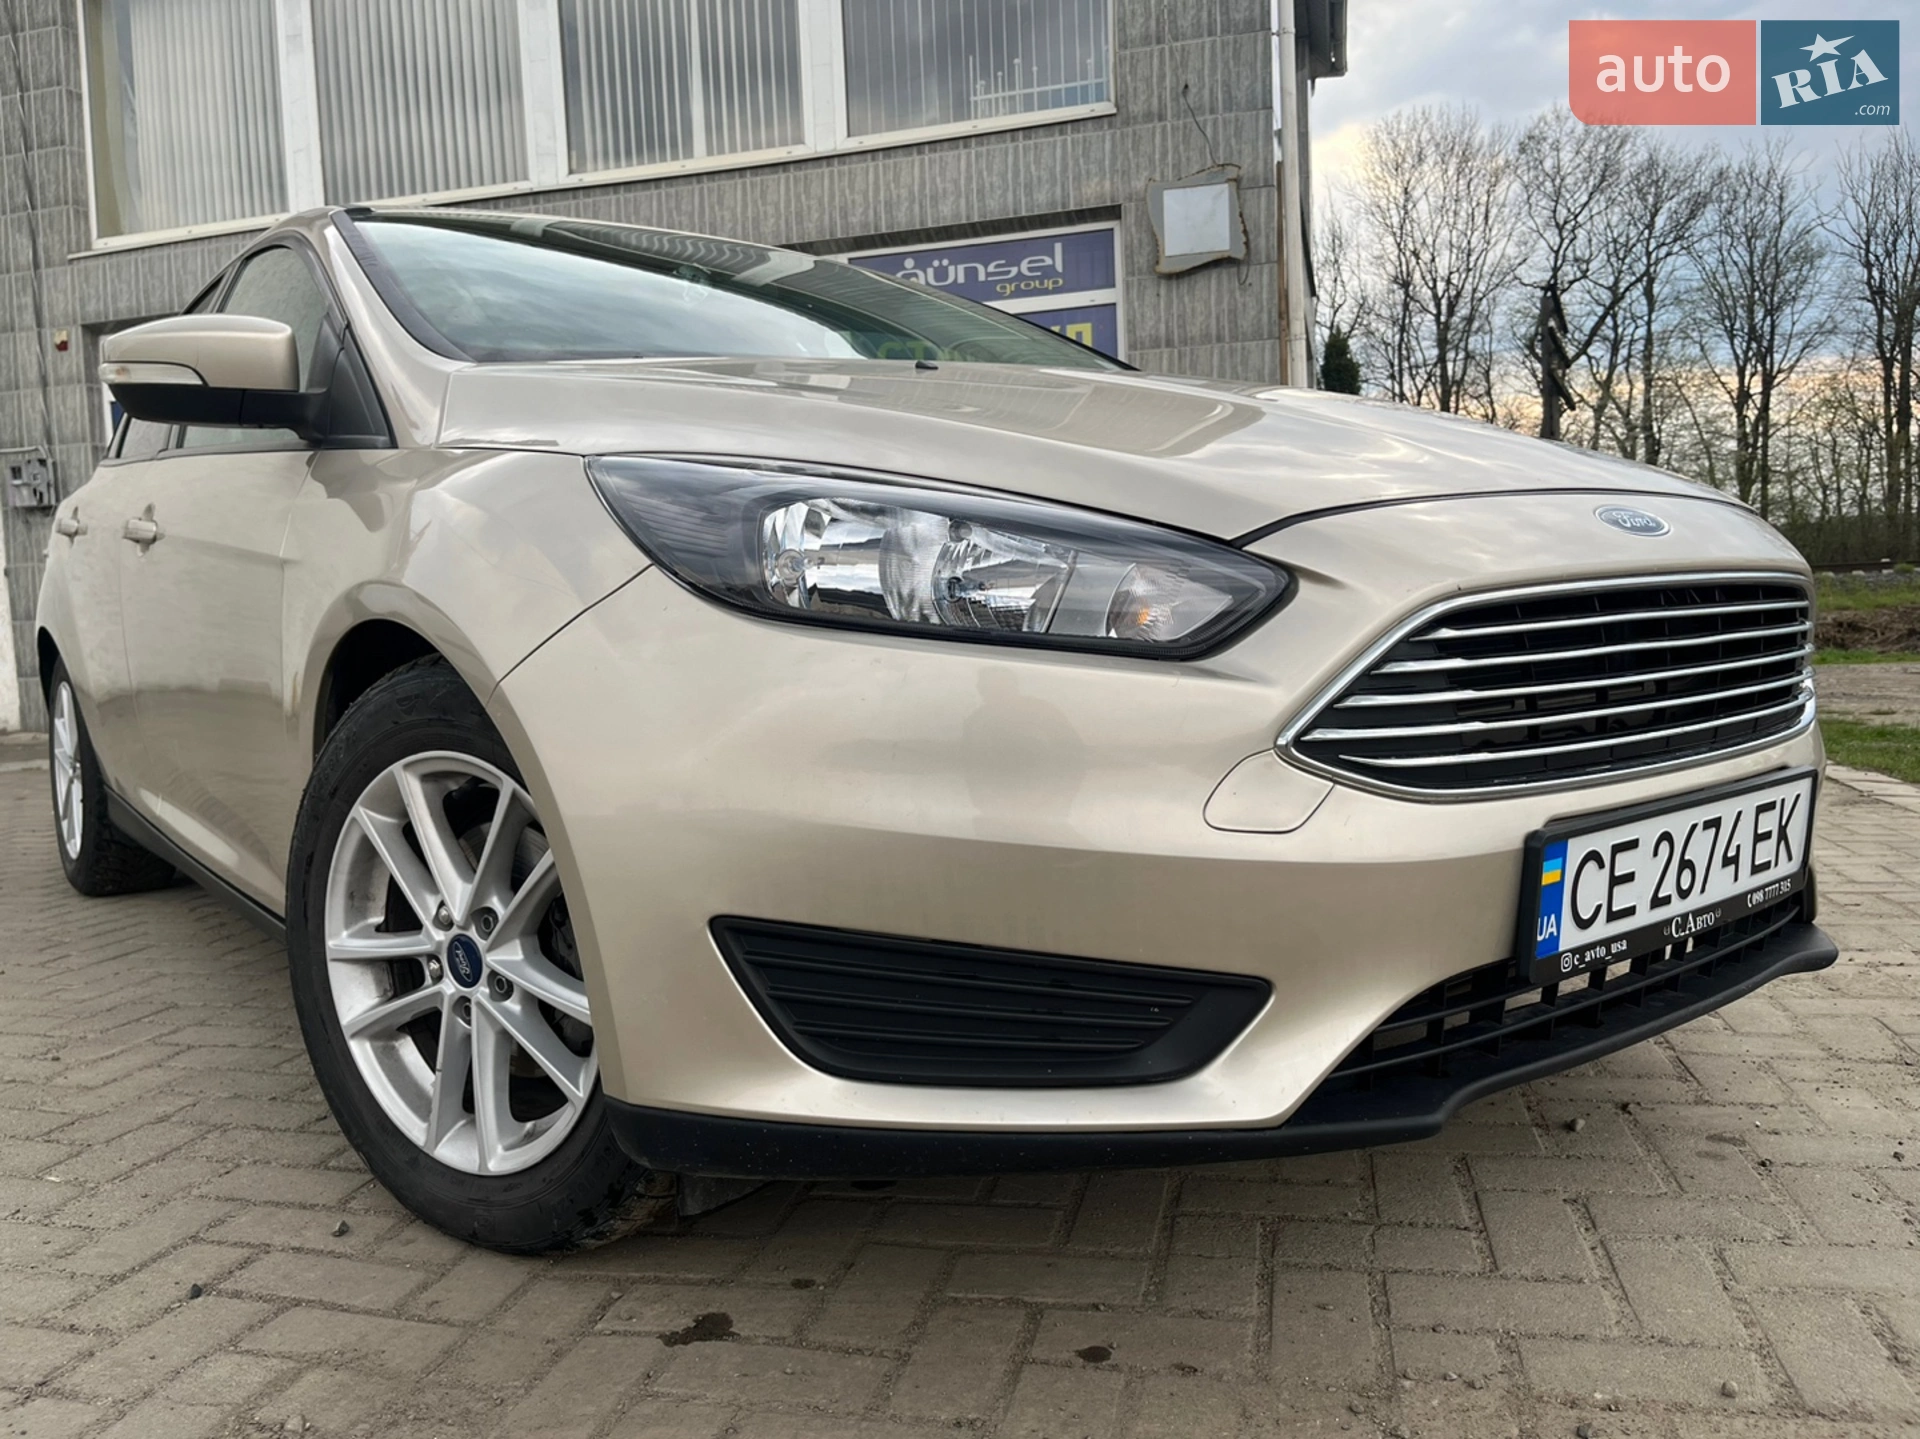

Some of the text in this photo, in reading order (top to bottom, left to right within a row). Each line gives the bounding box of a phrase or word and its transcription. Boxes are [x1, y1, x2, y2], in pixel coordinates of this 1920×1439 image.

[996, 277, 1063, 297] group
[1612, 511, 1657, 528] Ford
[1570, 793, 1801, 930] CE 2674 EK
[1537, 913, 1558, 941] UA
